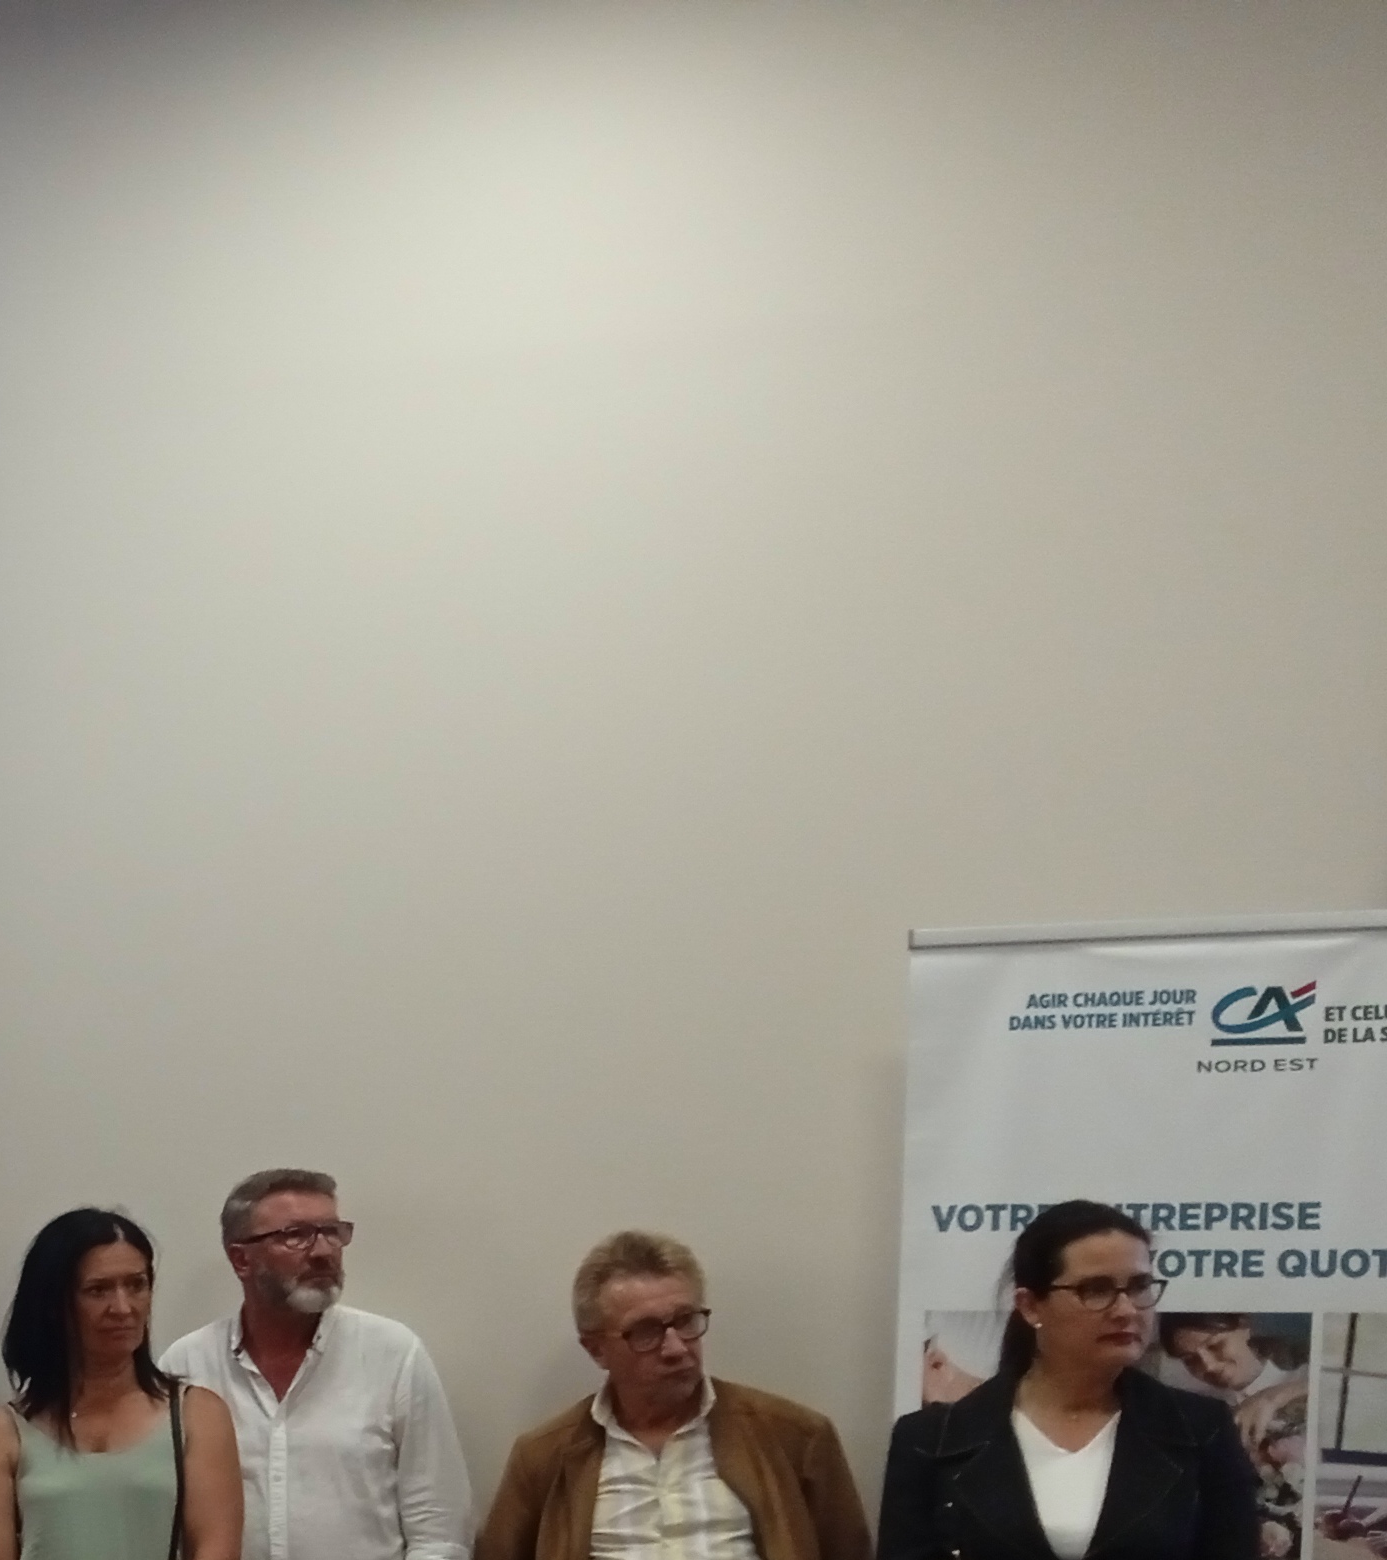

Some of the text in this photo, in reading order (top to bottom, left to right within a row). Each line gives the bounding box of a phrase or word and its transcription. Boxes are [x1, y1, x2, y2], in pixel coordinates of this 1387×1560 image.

[1026, 988, 1197, 1009] AGIR CHAQUE JOUR
[1008, 1006, 1195, 1031] DANS VOTRE INTÉRÊT
[1324, 1005, 1347, 1022] ET
[1323, 1027, 1348, 1044] DE
[1352, 1026, 1375, 1043] LA
[1196, 1058, 1318, 1073] NORD EST
[1113, 1201, 1322, 1231] TREPRISE
[1149, 1249, 1265, 1278] OTRE
